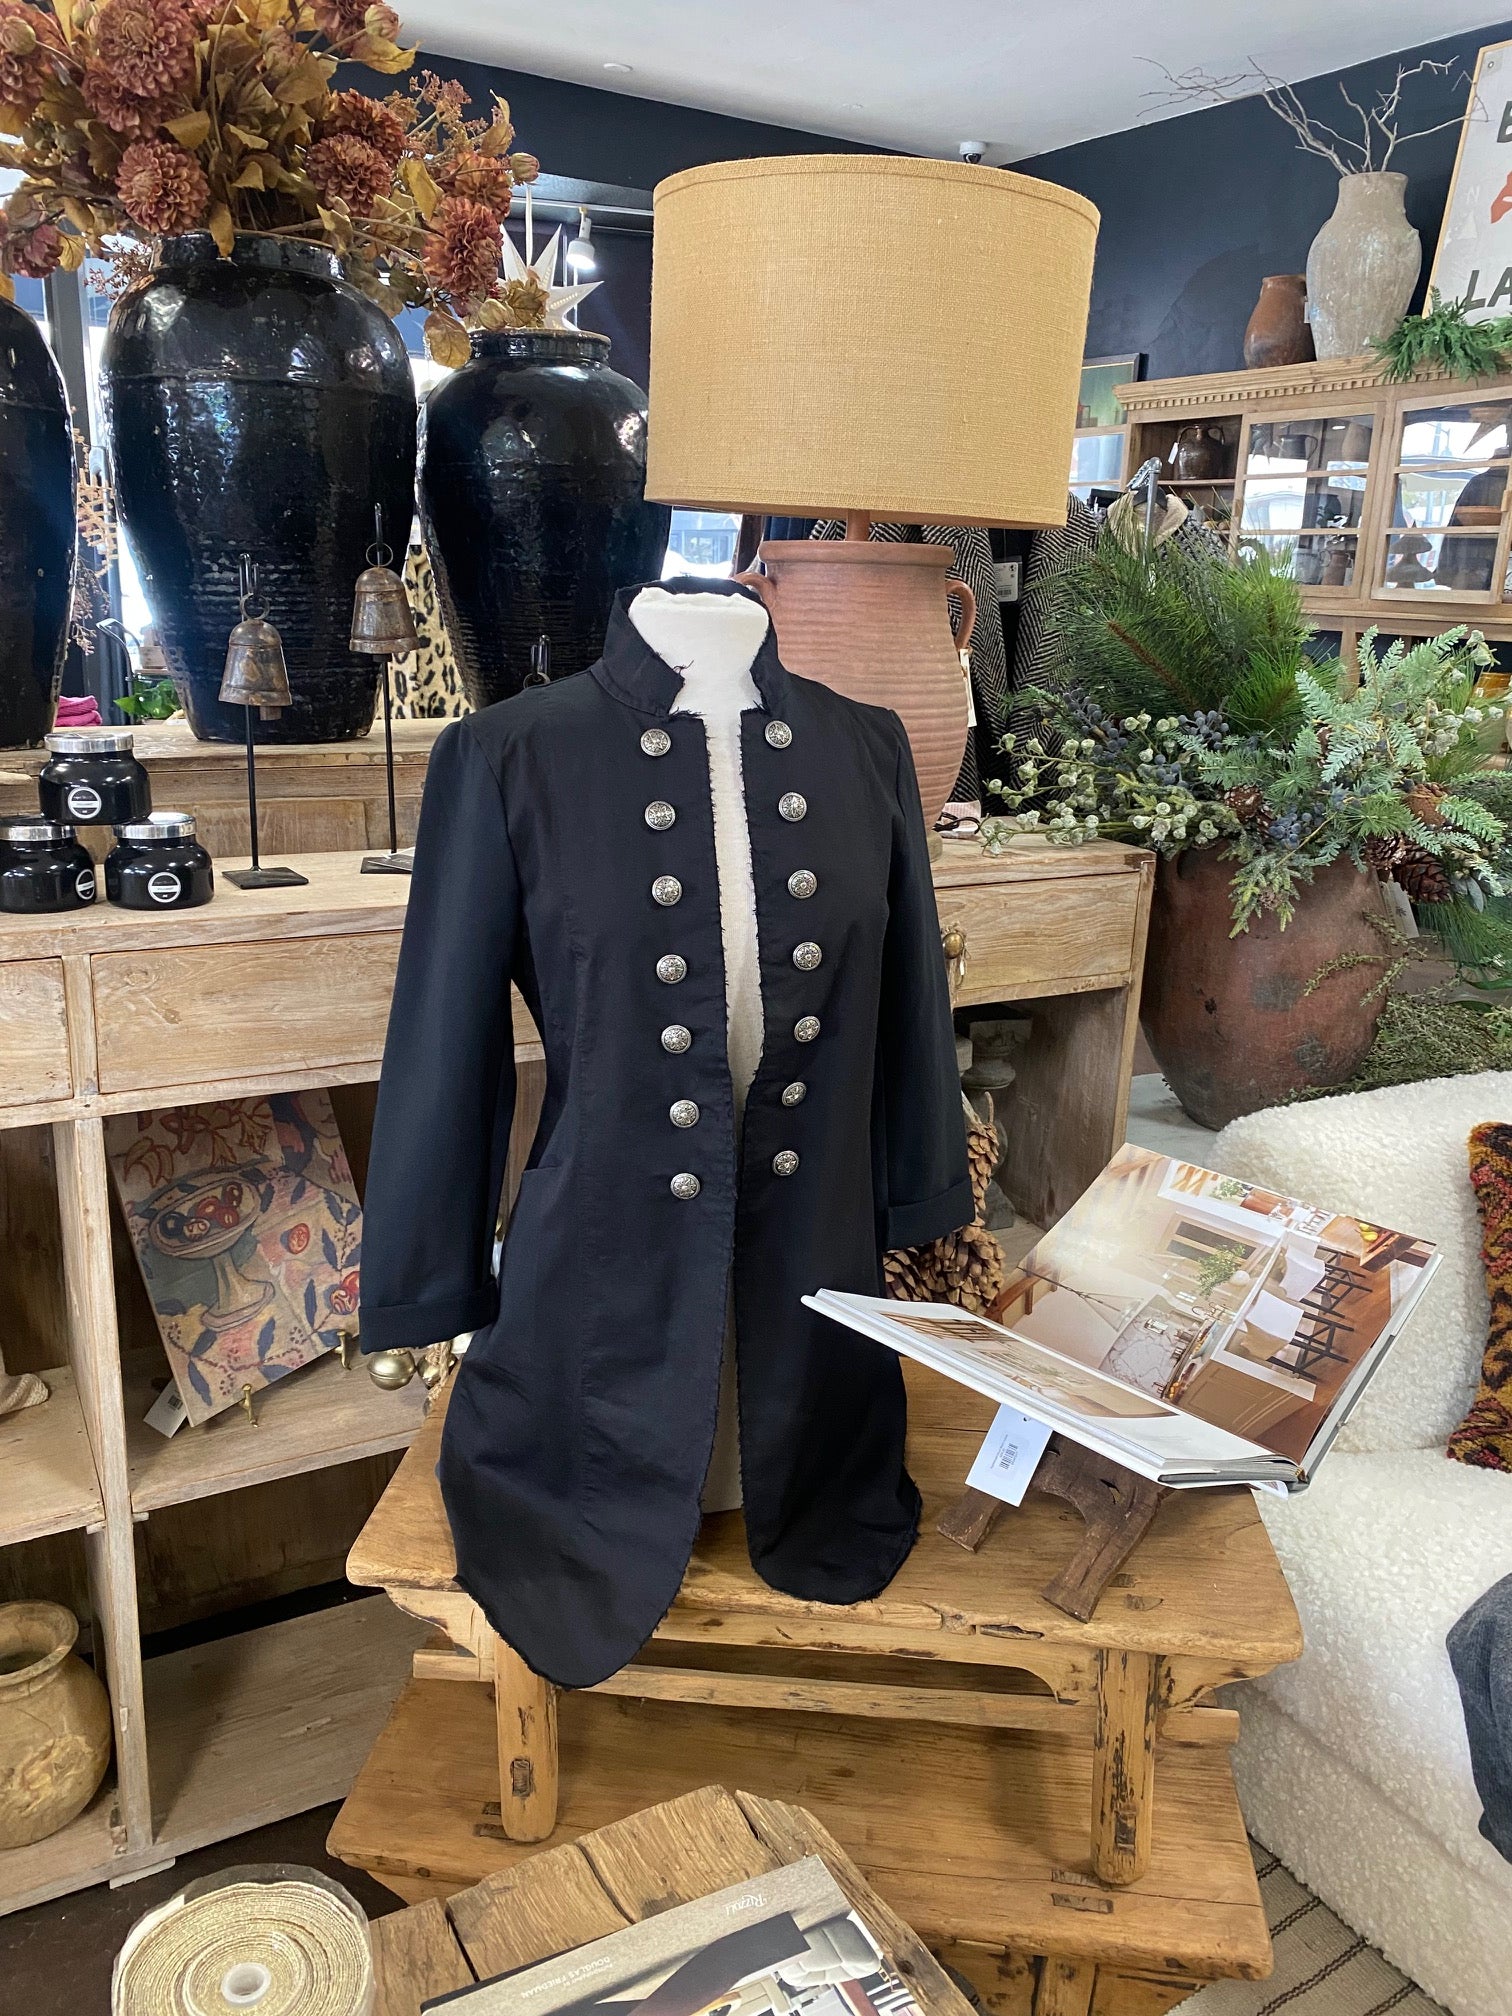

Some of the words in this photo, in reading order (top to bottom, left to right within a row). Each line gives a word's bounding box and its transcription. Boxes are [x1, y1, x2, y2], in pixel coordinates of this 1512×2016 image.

[725, 1893, 768, 1916] RIZZOLI
[567, 1955, 611, 1978] DOUGLAS
[520, 1974, 567, 1999] FRIEDMAN
